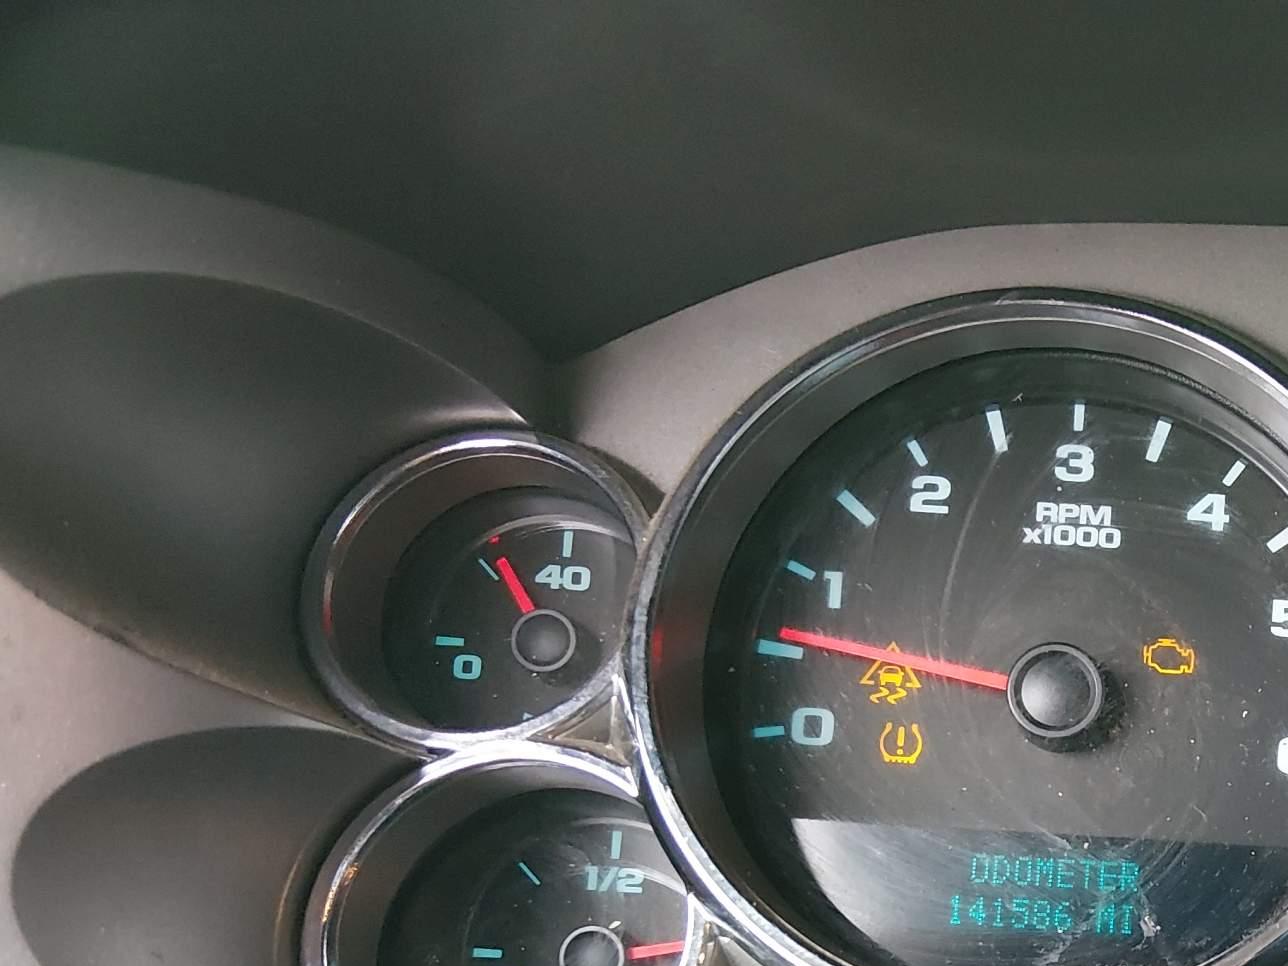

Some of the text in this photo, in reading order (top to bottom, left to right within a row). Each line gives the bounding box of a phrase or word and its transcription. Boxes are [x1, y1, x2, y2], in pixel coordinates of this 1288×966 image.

[1054, 443, 1094, 483] 3
[909, 475, 951, 514] 2
[1186, 493, 1229, 532] 4
[1035, 502, 1112, 526] RPM
[1021, 523, 1122, 549] x1000
[535, 564, 591, 592] 40
[823, 571, 843, 609] 1
[453, 654, 482, 680] 0
[791, 708, 834, 746] 0
[585, 865, 645, 893] 1/2
[971, 853, 1140, 892] ODOMETER
[949, 895, 1072, 932] 141586
